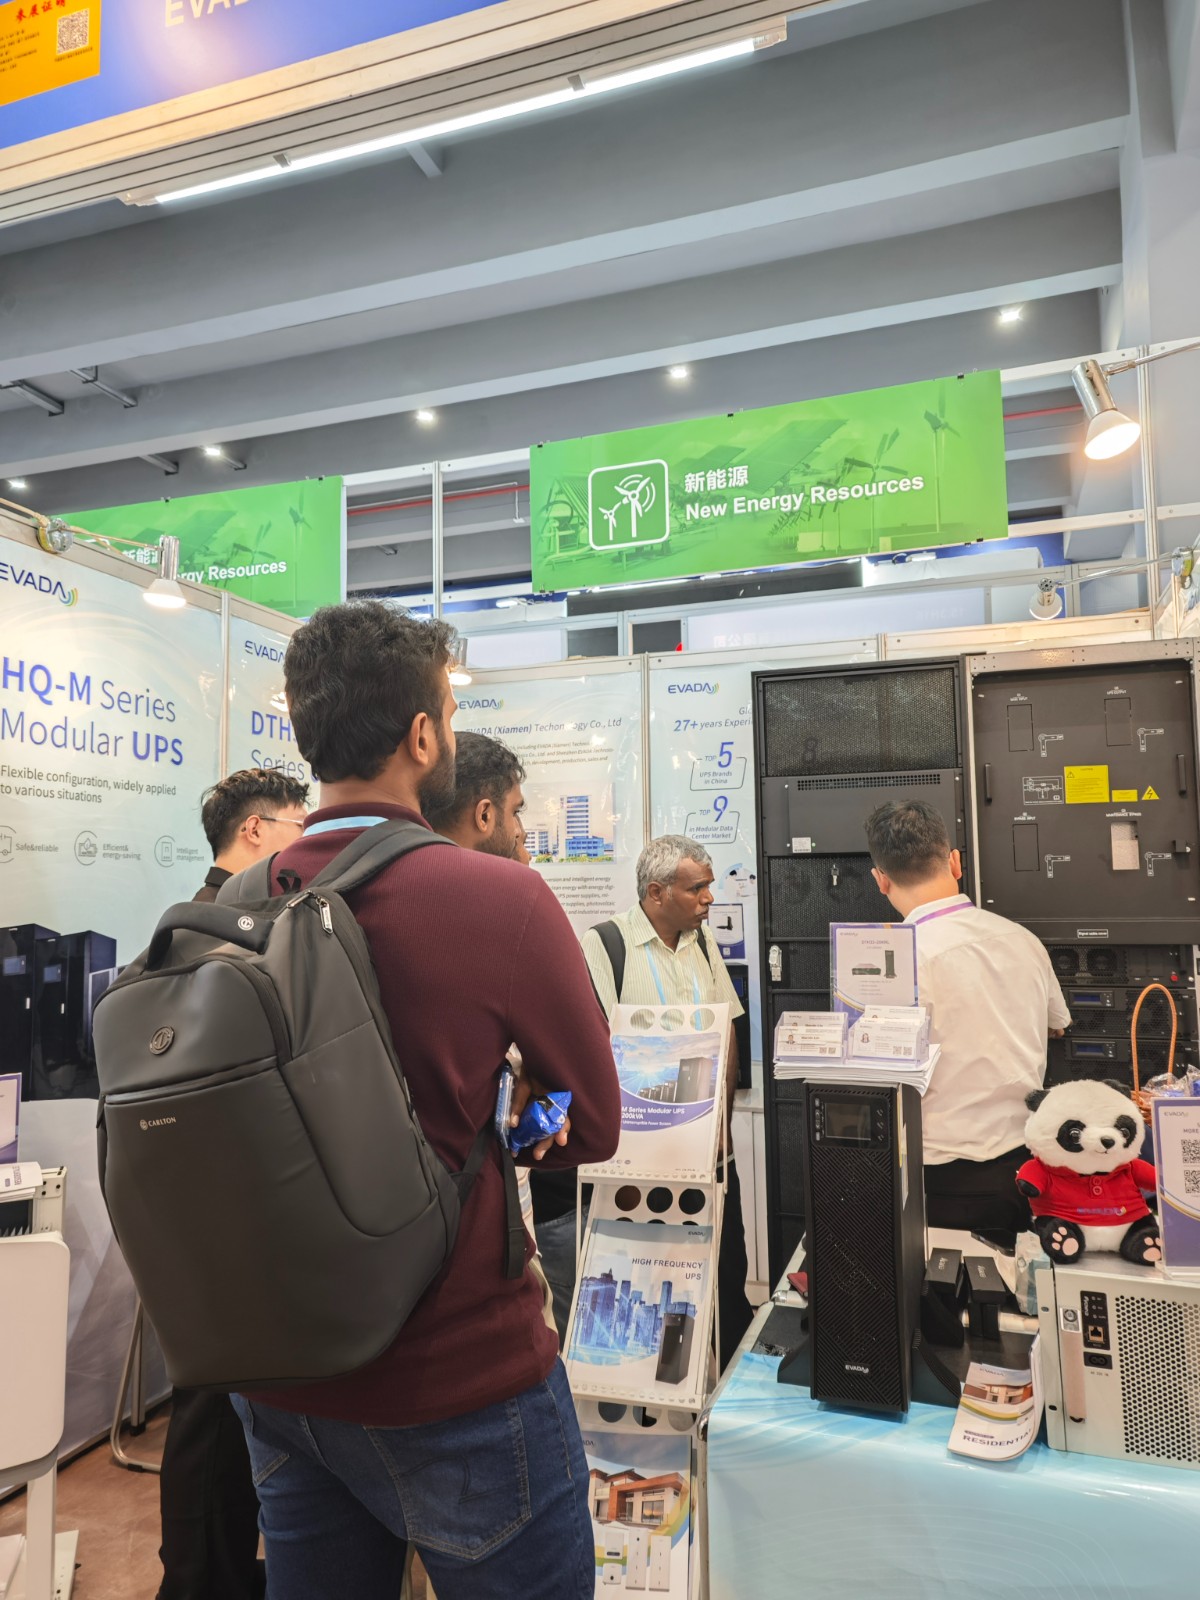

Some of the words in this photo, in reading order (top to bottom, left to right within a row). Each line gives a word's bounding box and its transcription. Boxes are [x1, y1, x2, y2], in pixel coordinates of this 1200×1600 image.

[684, 465, 749, 494] 新能源
[685, 502, 727, 521] New
[733, 492, 804, 513] Energy
[811, 475, 924, 505] Resources
[209, 561, 287, 581] Resources
[1, 656, 92, 706] HQ-M
[100, 681, 177, 723] Series
[667, 682, 712, 694] EVADA
[459, 698, 498, 711] EVADA
[494, 724, 533, 737] (Xiamen)
[607, 717, 622, 728] Ltd
[673, 719, 699, 732] 27+
[700, 720, 723, 732] years
[1, 708, 125, 757] Modular
[133, 731, 184, 766] UPS
[717, 741, 735, 768] 5
[0, 765, 44, 781] Flexible
[46, 773, 112, 791] configuration,
[113, 780, 143, 795] widely
[145, 783, 177, 797] applied
[711, 770, 733, 778] Brands
[0, 784, 12, 794] to
[14, 786, 55, 799] various
[57, 790, 103, 804] situations
[713, 794, 729, 822] 9
[647, 1106, 672, 1115] Modular
[147, 1116, 177, 1127] CARLTON
[632, 1257, 652, 1266] HIGH
[653, 1259, 704, 1270] FREQUENCY
[685, 1272, 702, 1281] UPS
[844, 1364, 865, 1373] EVADA
